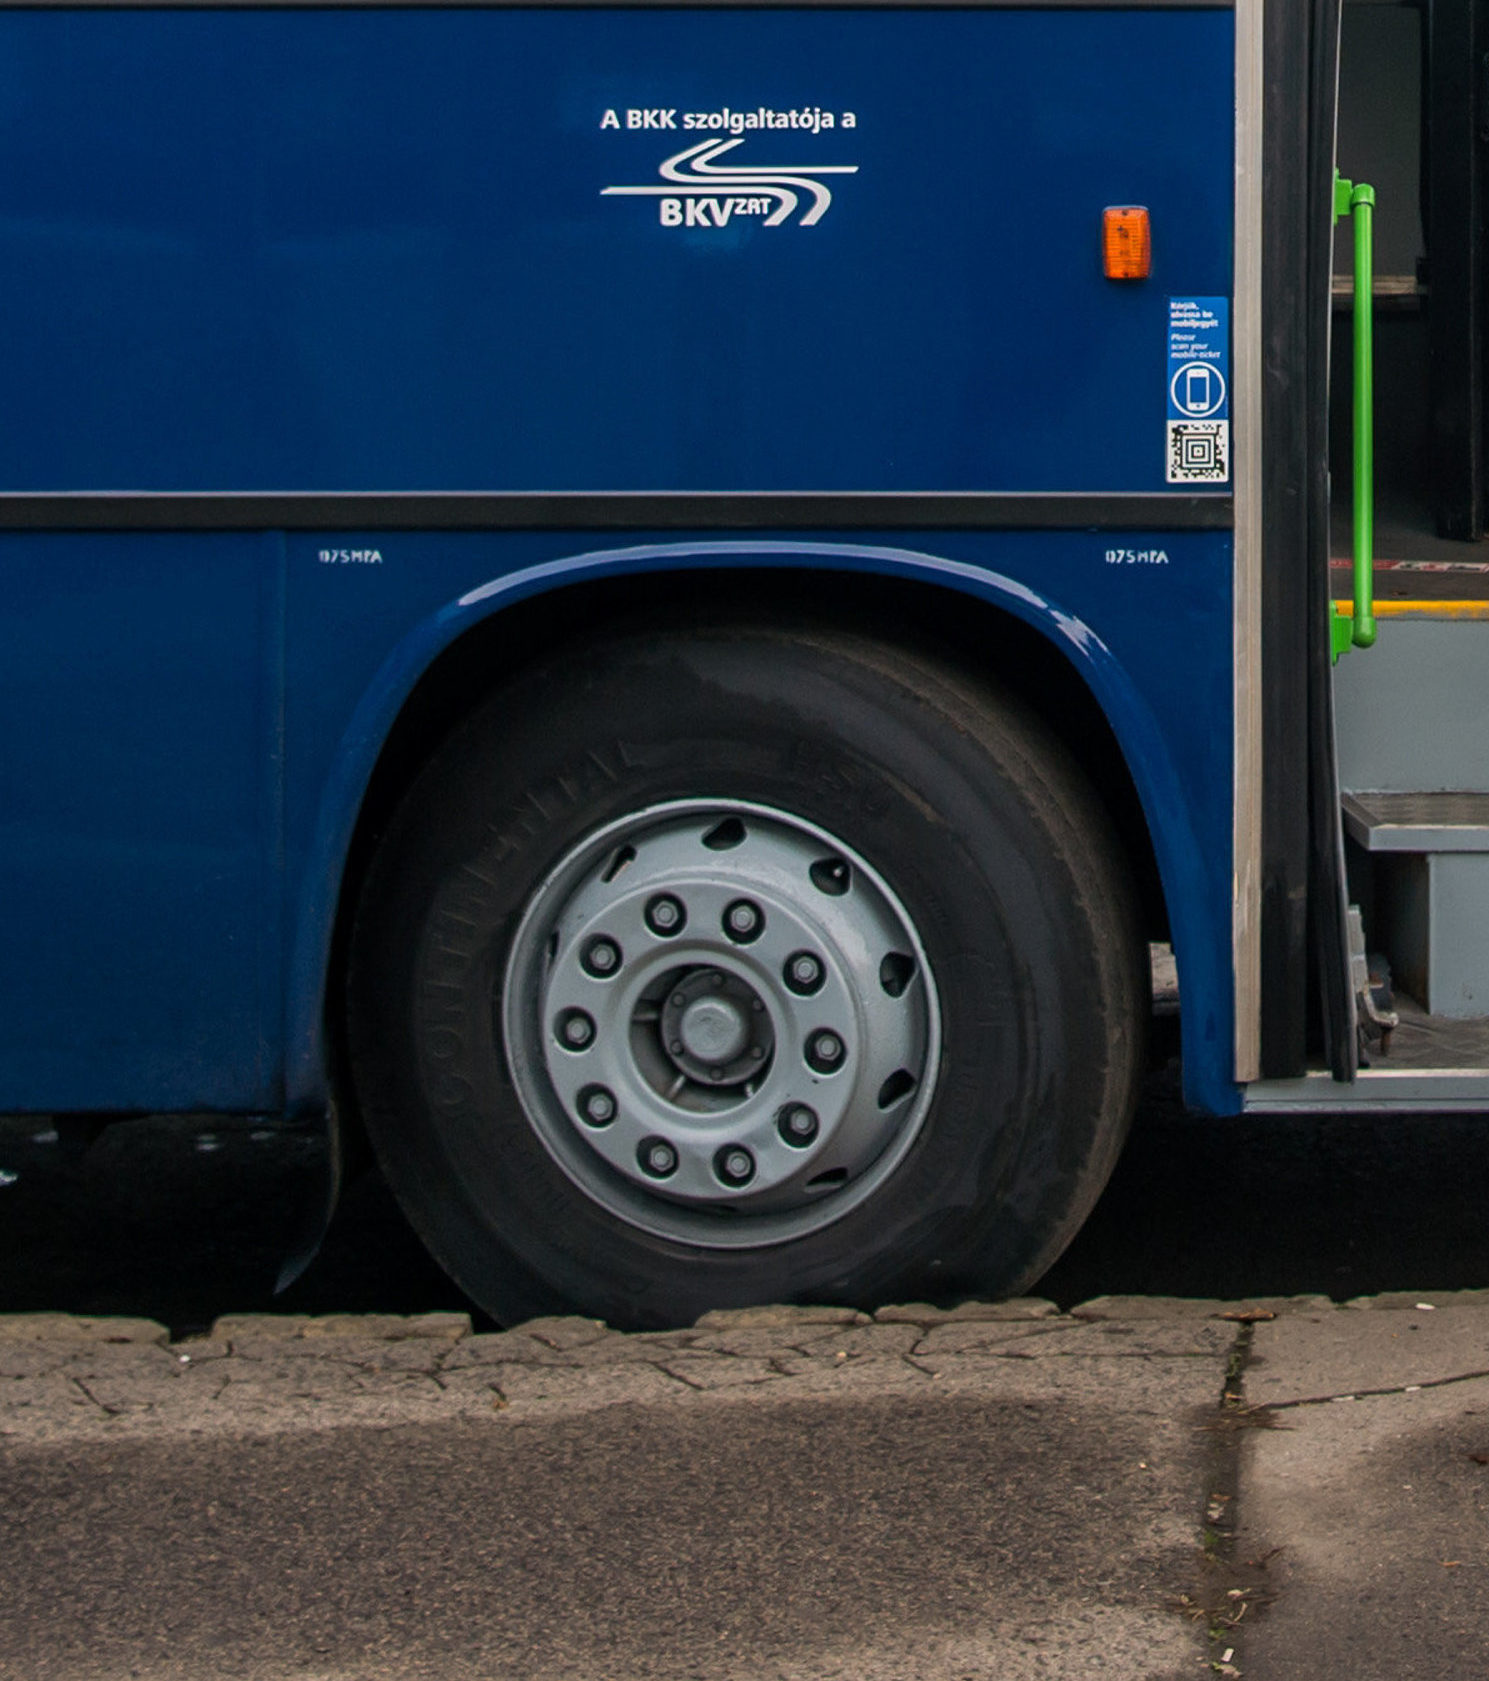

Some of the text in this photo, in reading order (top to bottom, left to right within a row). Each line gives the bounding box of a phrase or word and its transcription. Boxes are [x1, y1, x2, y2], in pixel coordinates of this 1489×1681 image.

[600, 107, 857, 134] A BKK szolgaltatója a
[660, 198, 734, 227] BKV
